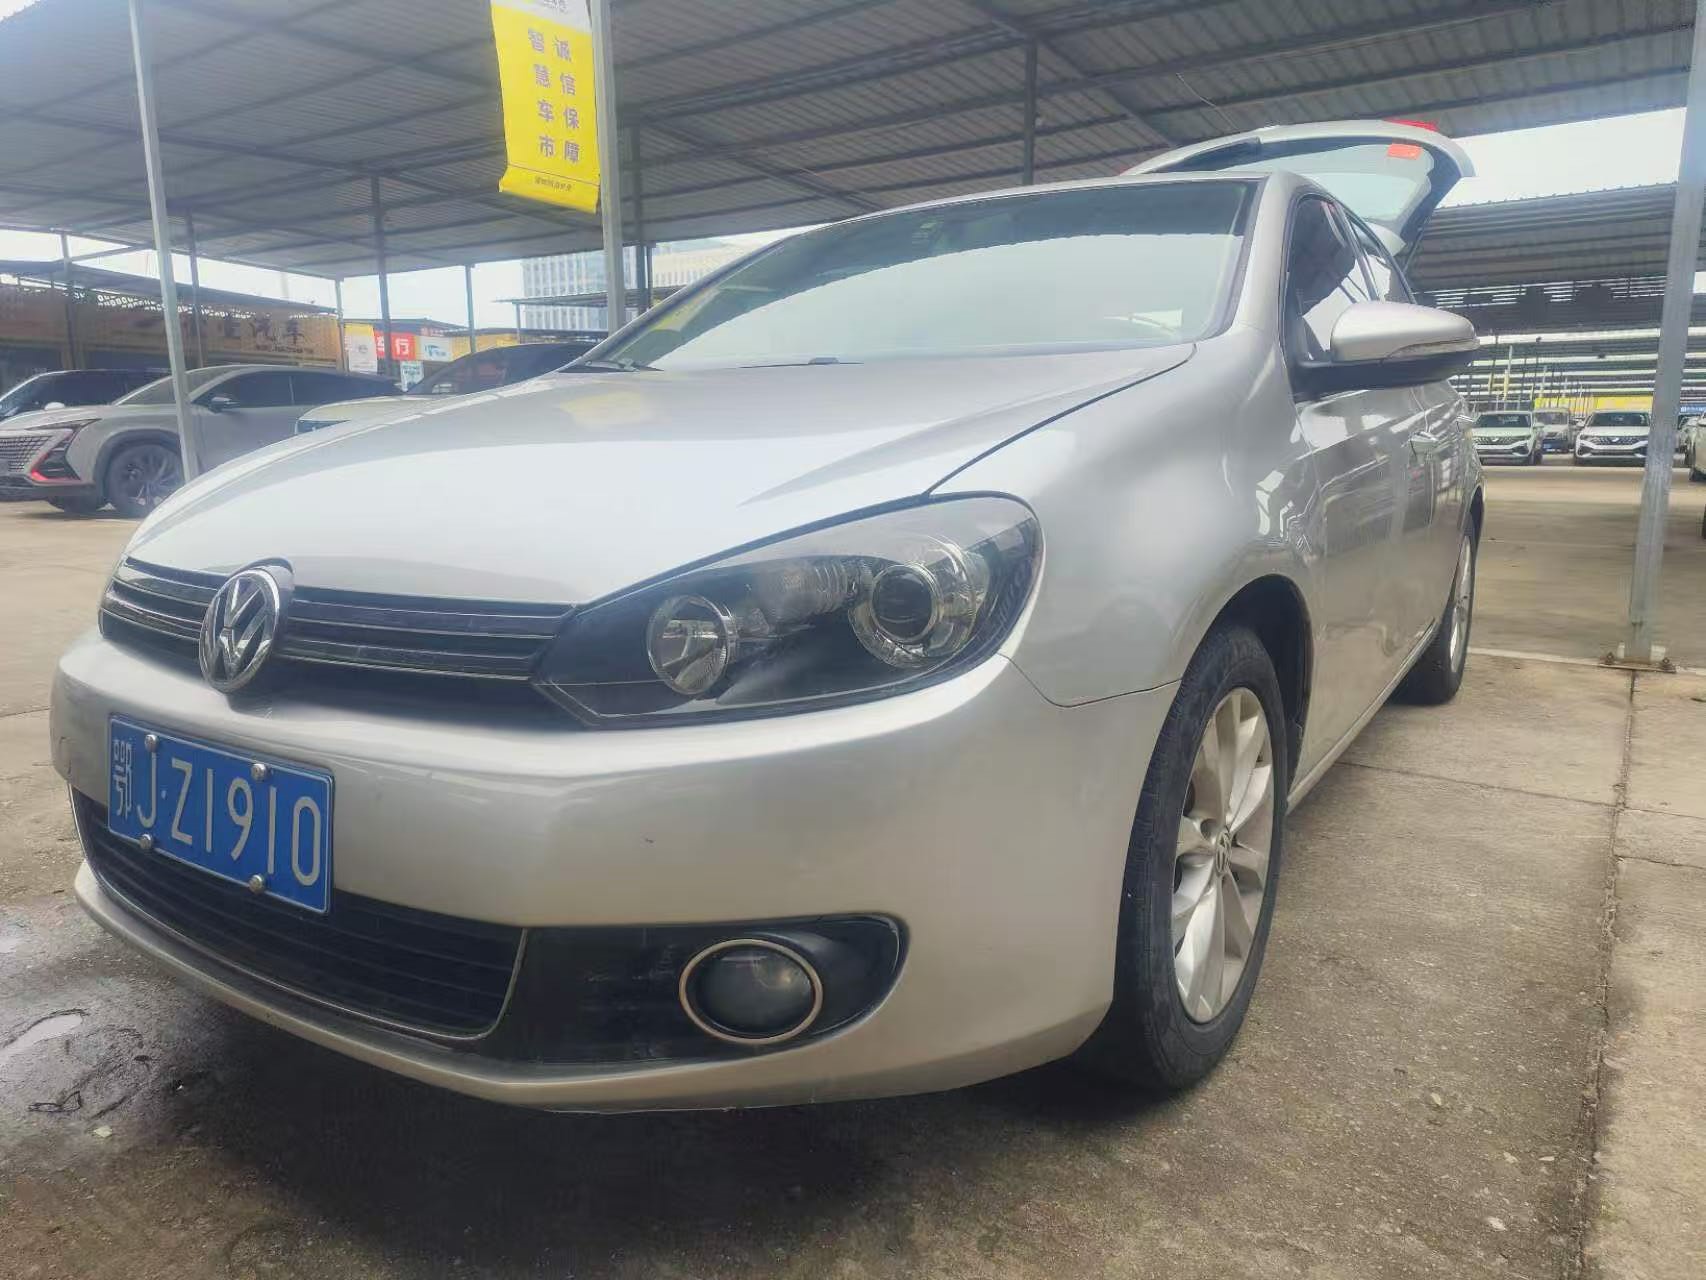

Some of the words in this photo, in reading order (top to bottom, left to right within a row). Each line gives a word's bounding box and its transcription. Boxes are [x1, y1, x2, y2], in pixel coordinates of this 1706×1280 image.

[528, 28, 554, 158] 智慧车市
[555, 36, 580, 164] 诚信保障
